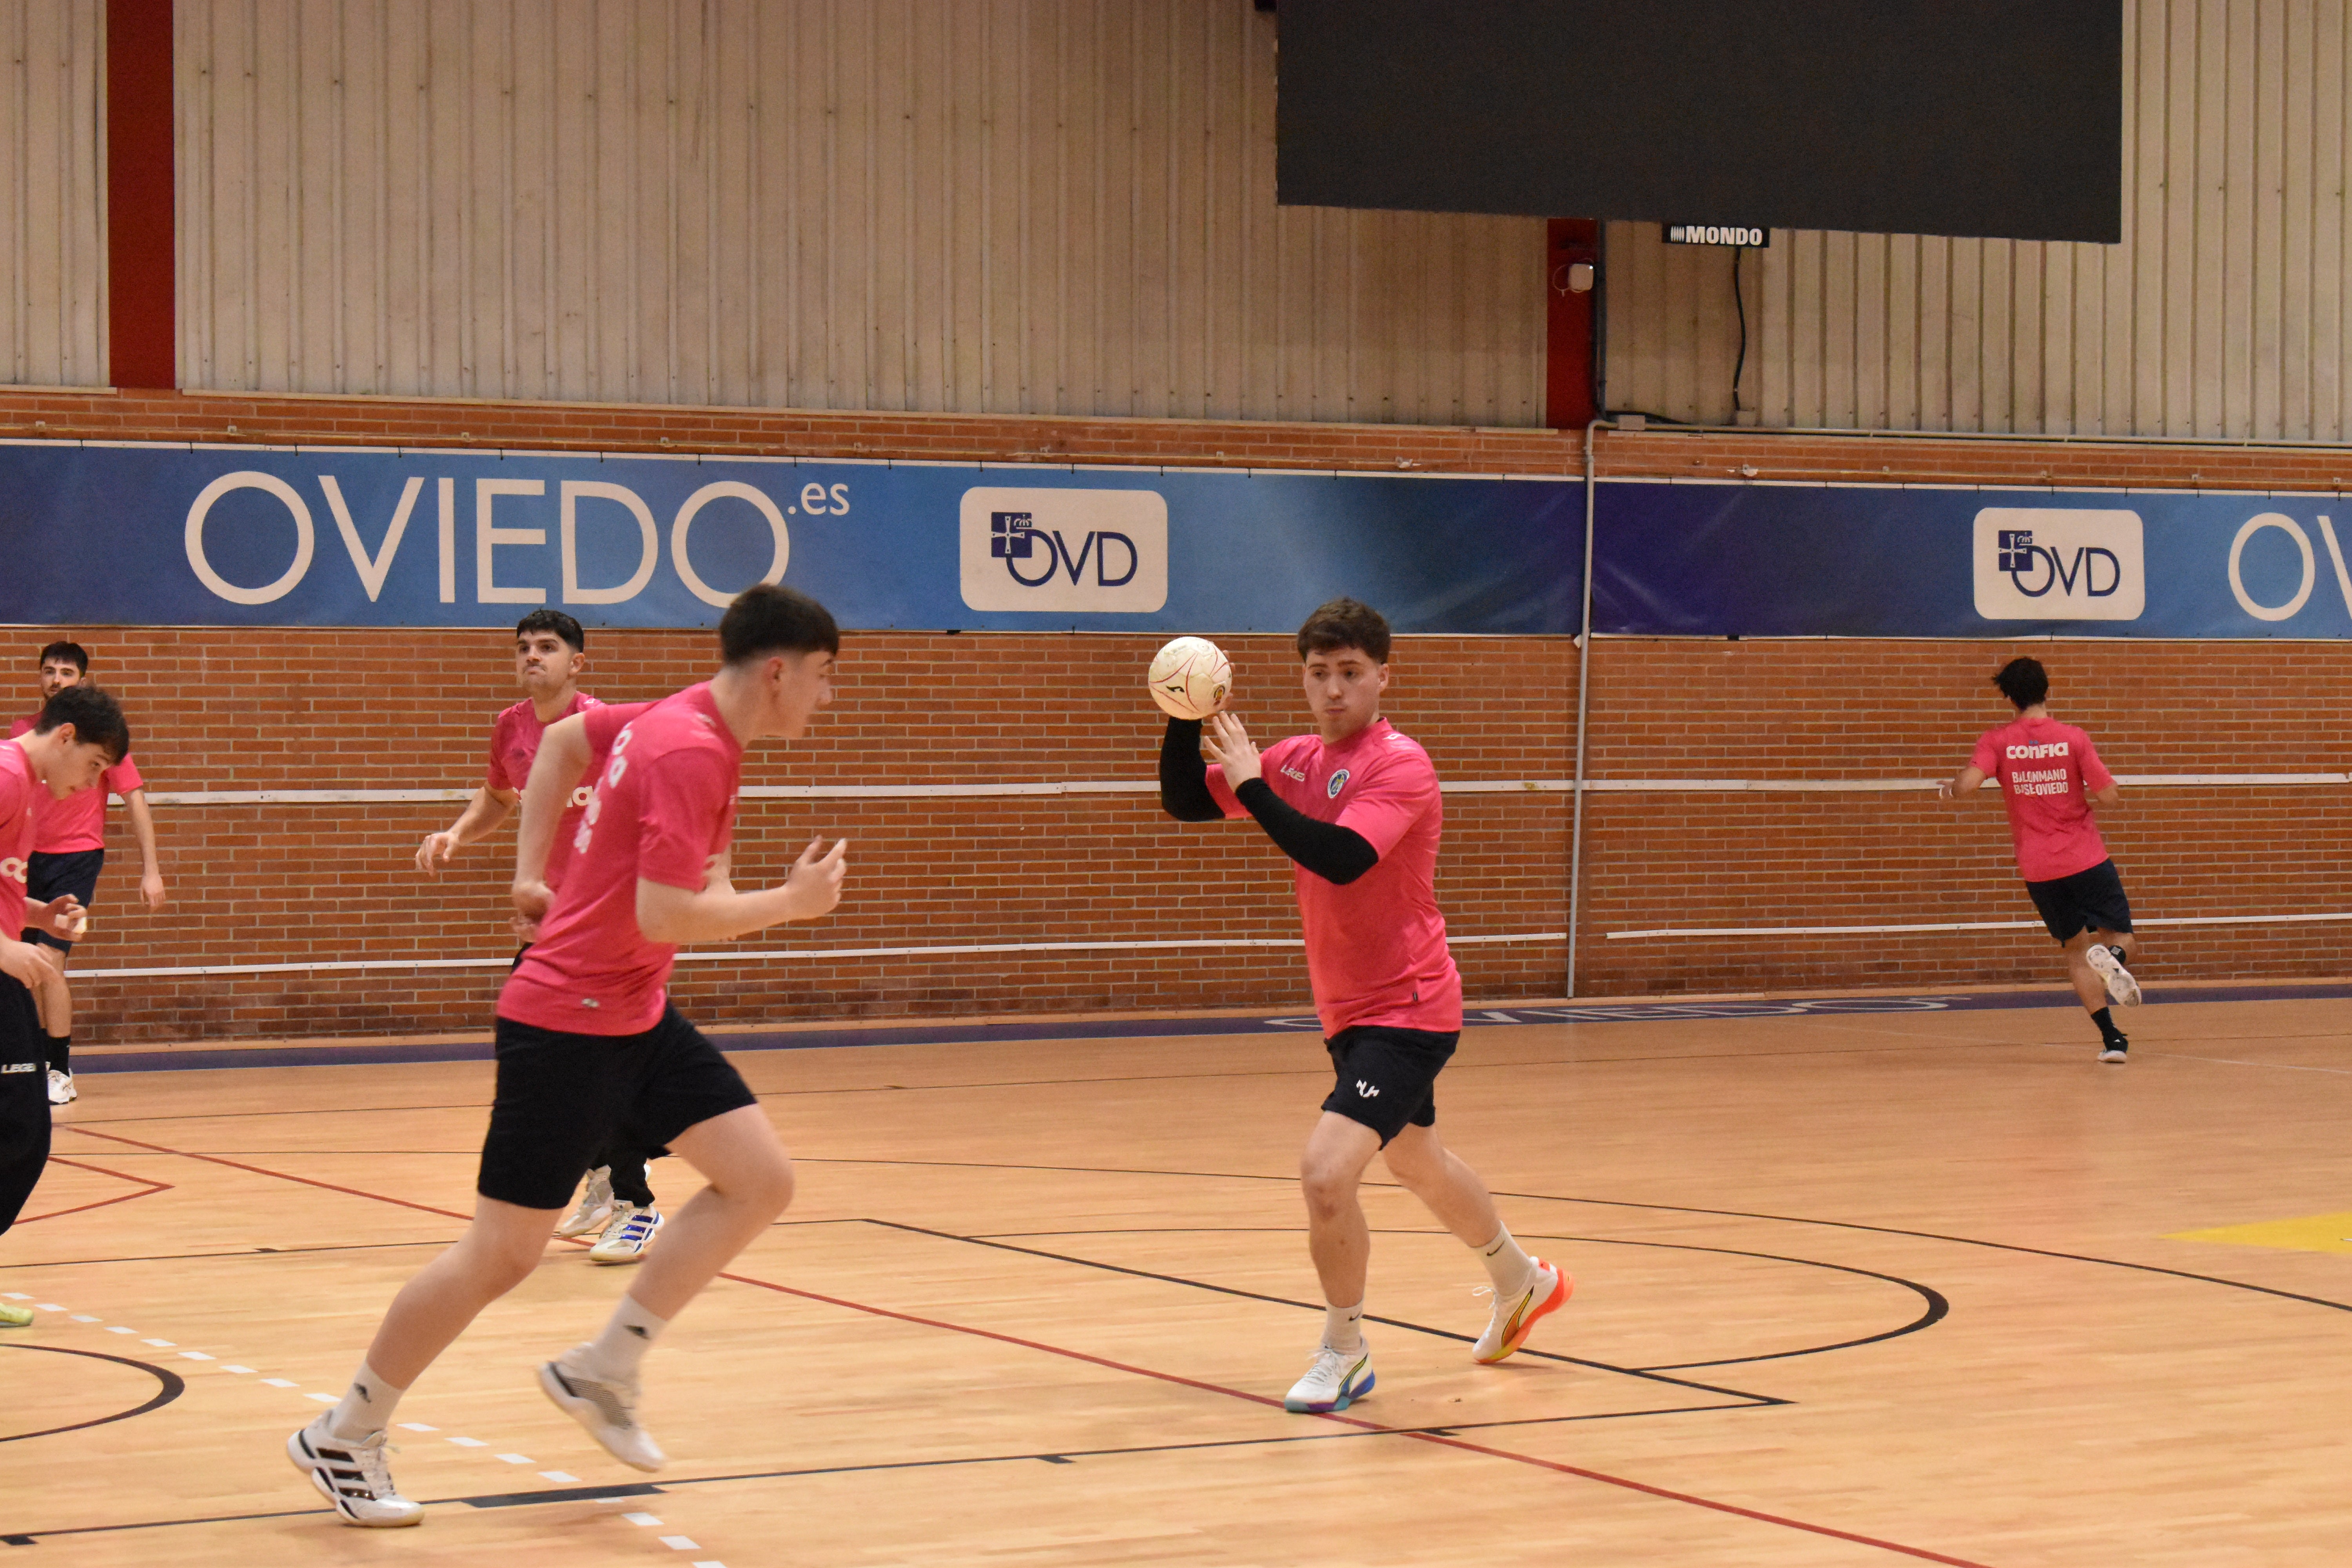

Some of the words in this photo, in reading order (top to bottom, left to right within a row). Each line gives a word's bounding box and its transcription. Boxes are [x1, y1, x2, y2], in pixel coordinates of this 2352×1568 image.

[1686, 225, 1762, 246] MONDO
[1005, 529, 1138, 587] OVD
[2012, 545, 2120, 597] OVD
